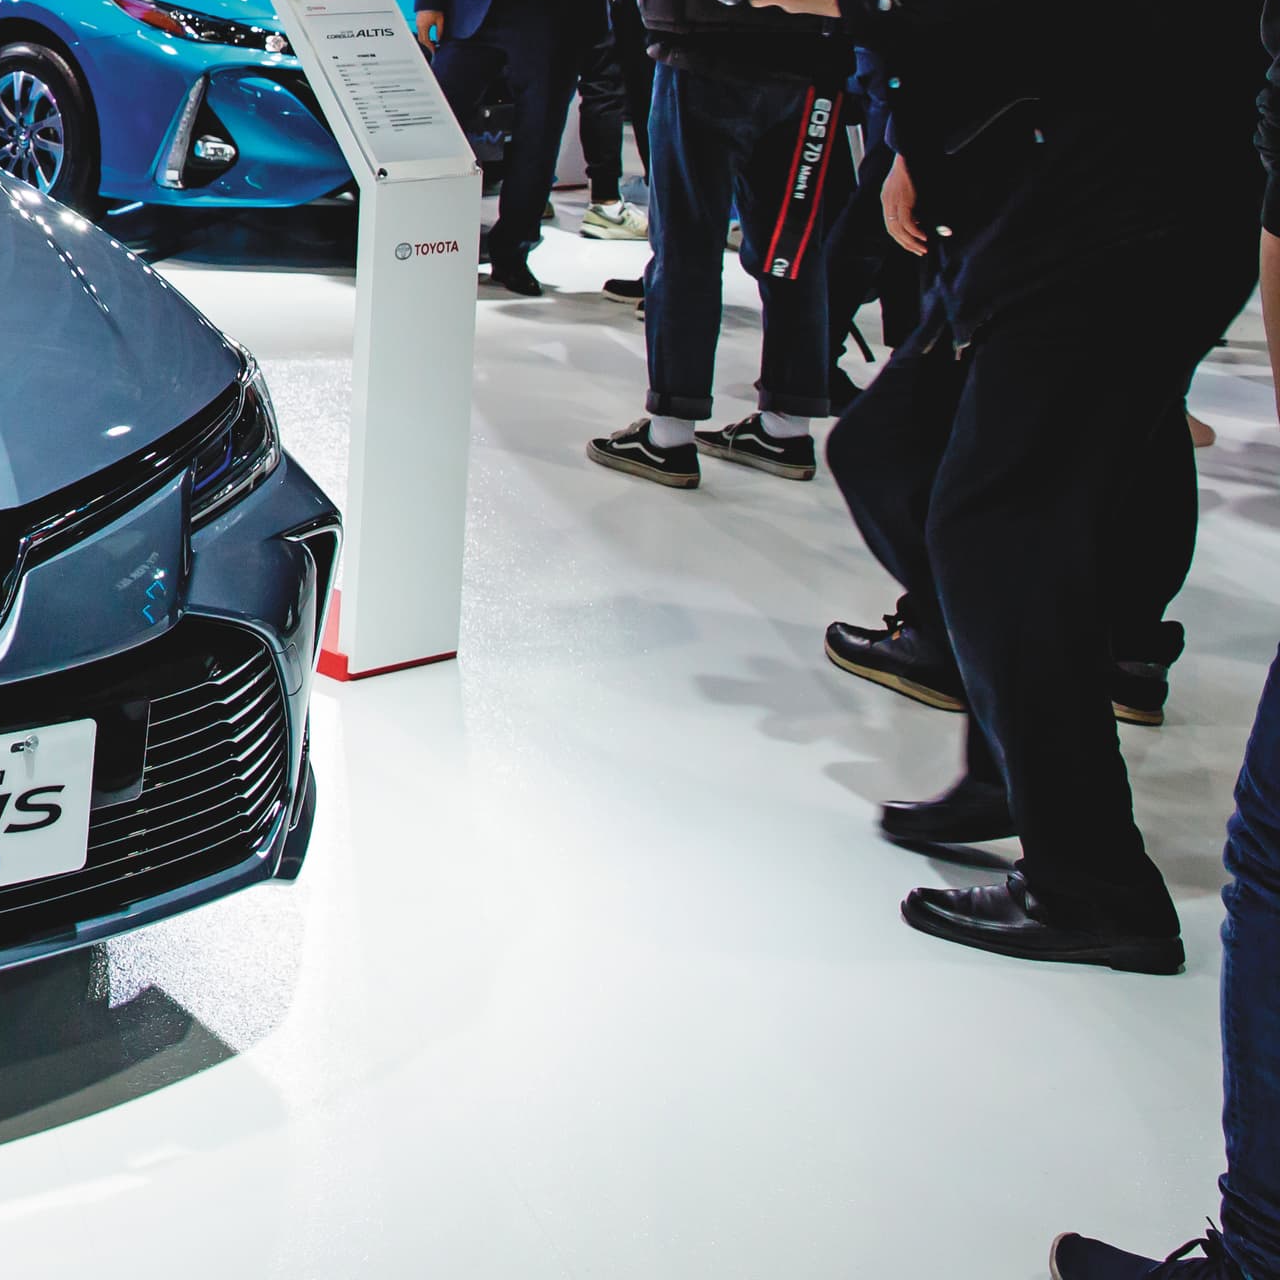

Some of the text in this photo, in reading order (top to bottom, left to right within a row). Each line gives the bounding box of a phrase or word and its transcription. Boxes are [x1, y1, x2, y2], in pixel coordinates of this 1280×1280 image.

[356, 28, 394, 38] ALTIS
[807, 98, 832, 138] EOS
[802, 143, 823, 162] 7D
[414, 240, 459, 256] TOYOTA
